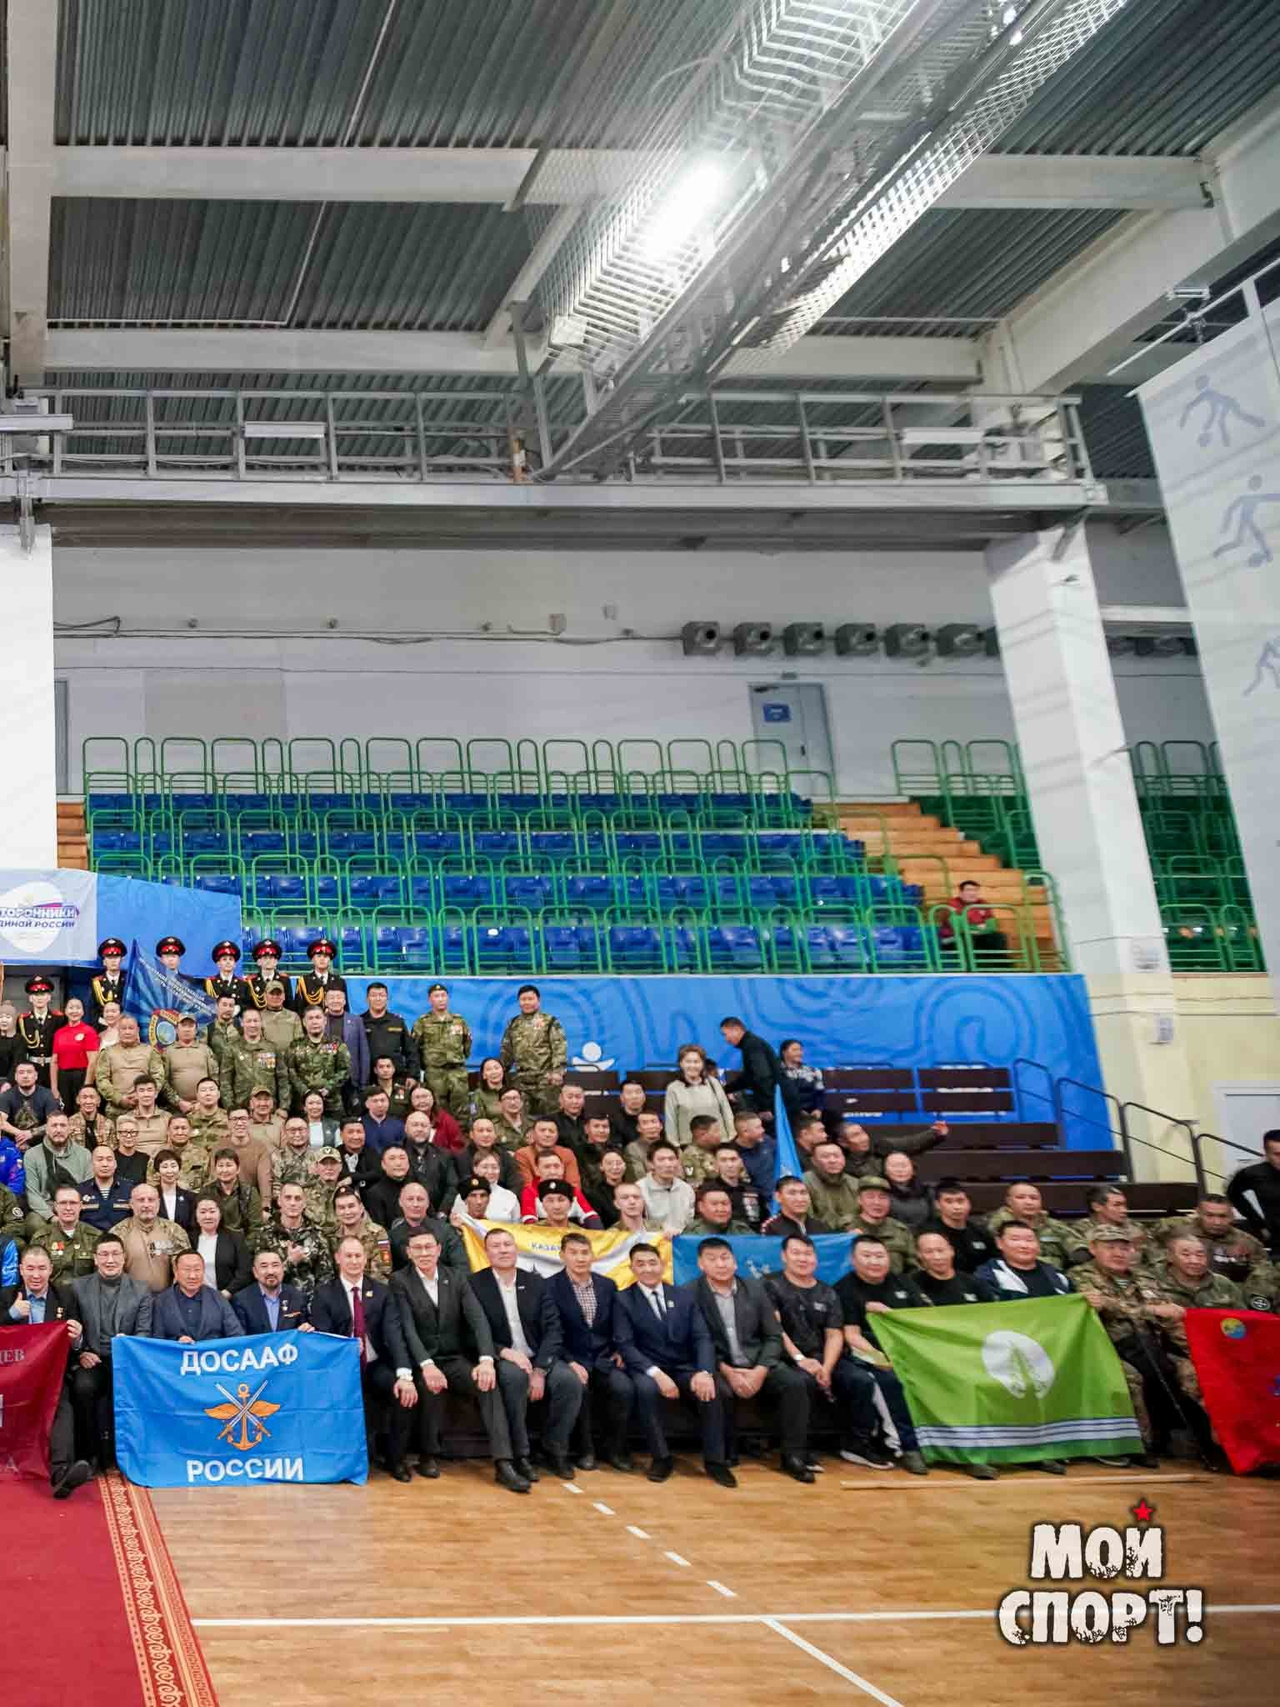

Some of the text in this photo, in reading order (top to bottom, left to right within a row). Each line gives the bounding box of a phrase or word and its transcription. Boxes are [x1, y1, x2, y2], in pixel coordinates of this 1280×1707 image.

[34, 920, 75, 928] РОССИИ
[180, 1343, 299, 1376] ДОСААФ
[186, 1457, 304, 1482] РОССИИ
